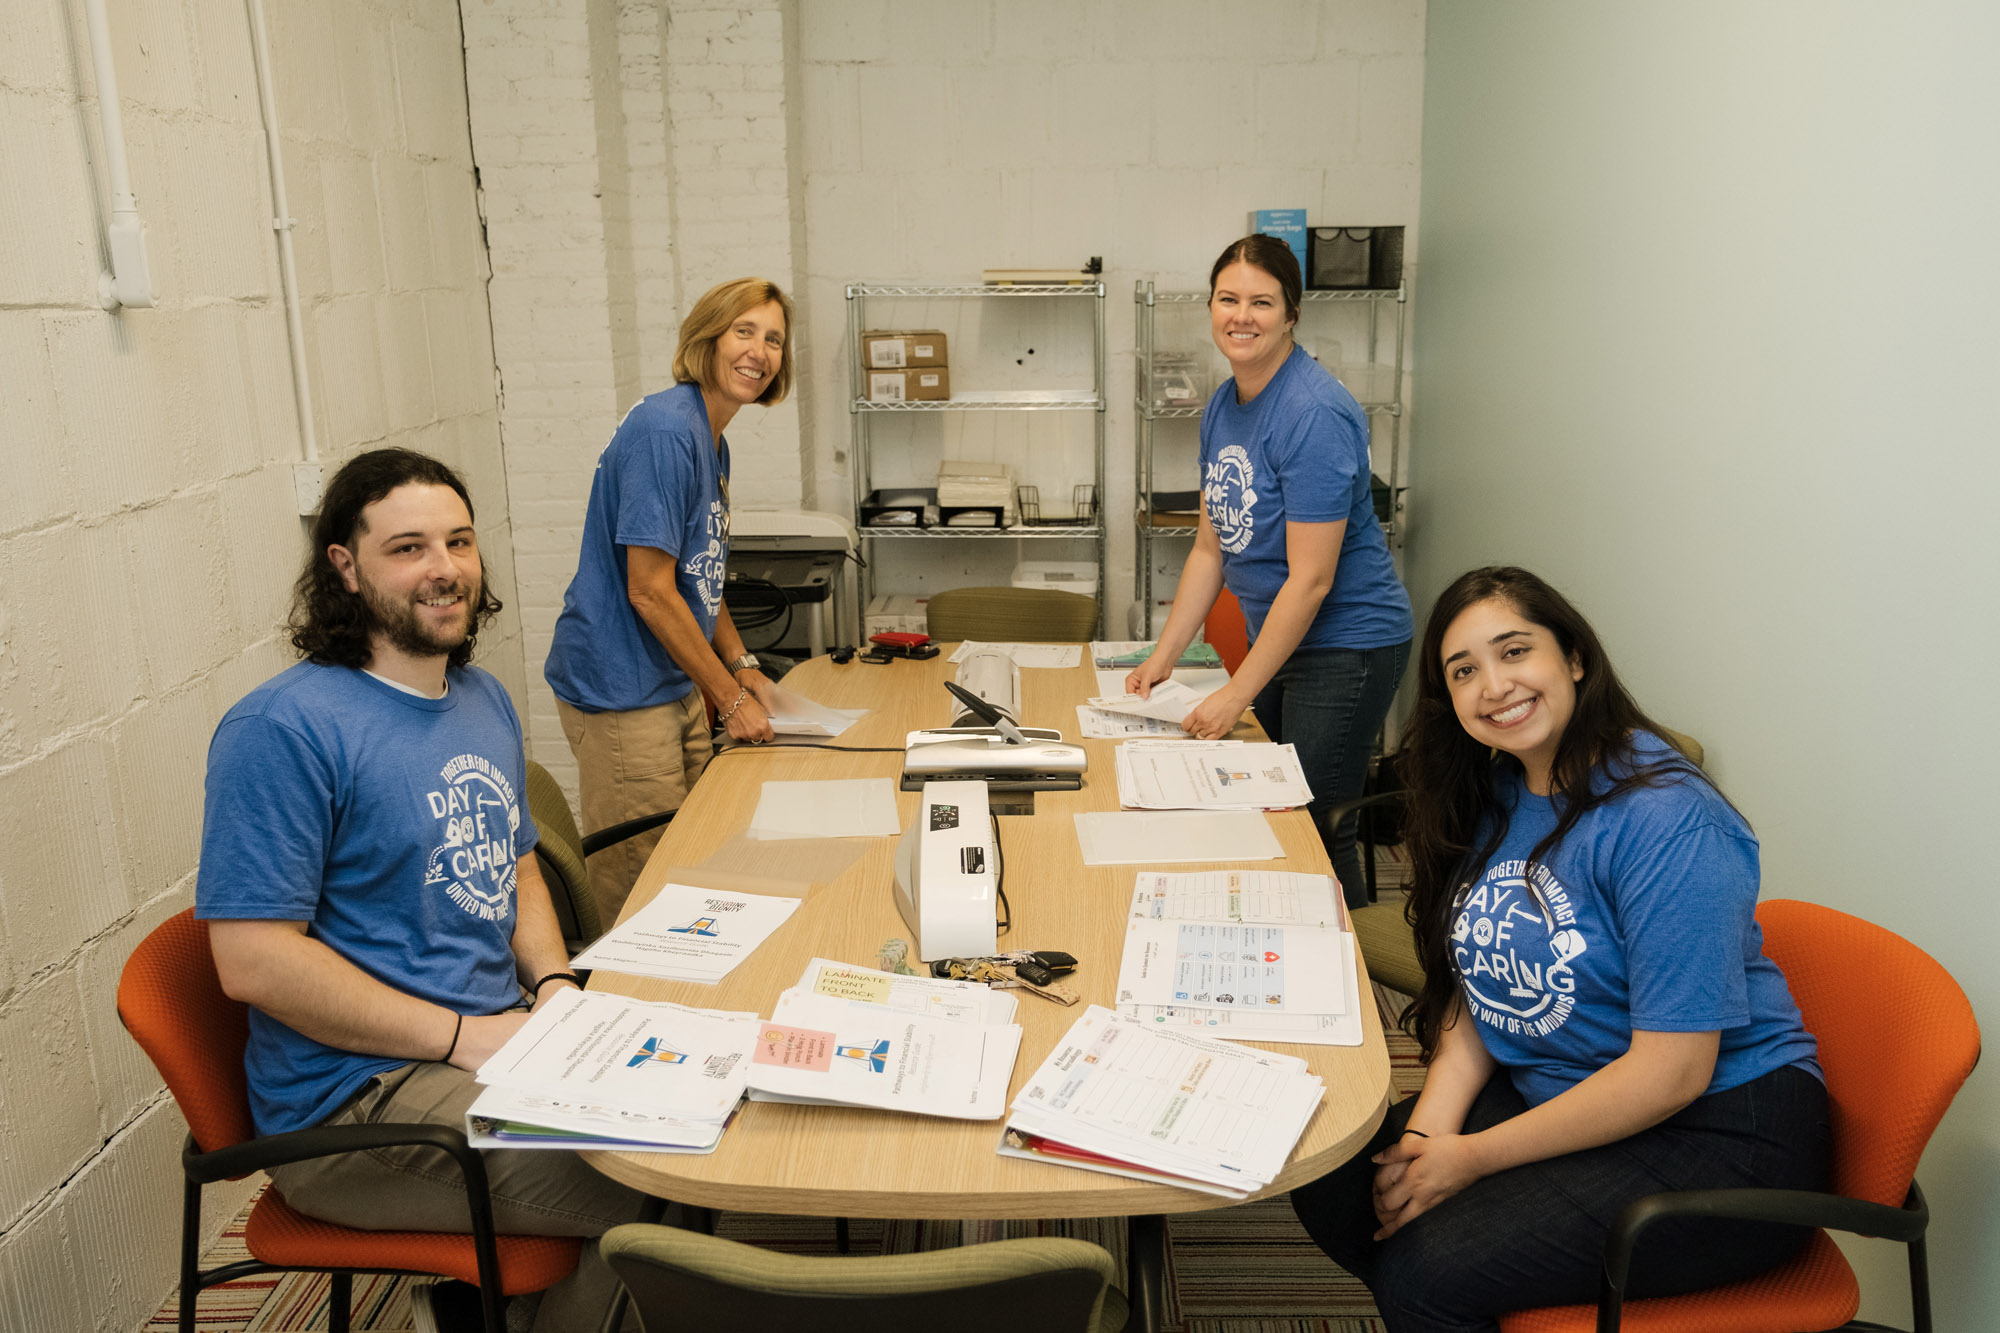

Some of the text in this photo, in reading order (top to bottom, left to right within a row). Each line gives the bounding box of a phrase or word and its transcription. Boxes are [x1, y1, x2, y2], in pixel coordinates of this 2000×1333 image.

[440, 754, 515, 803] TOGETHER FOR IMPACT
[427, 784, 470, 819] DAY
[461, 813, 486, 843] OF
[445, 881, 480, 915] UNITED
[1542, 876, 1577, 927] IMPACT
[1472, 917, 1514, 950] OF
[822, 978, 867, 989] FRONT
[825, 969, 887, 984] LAMINATE
[1455, 947, 1576, 999] CARING
[841, 988, 875, 998] BACK
[1481, 1008, 1505, 1029] WAY
[1507, 1017, 1521, 1034] OF
